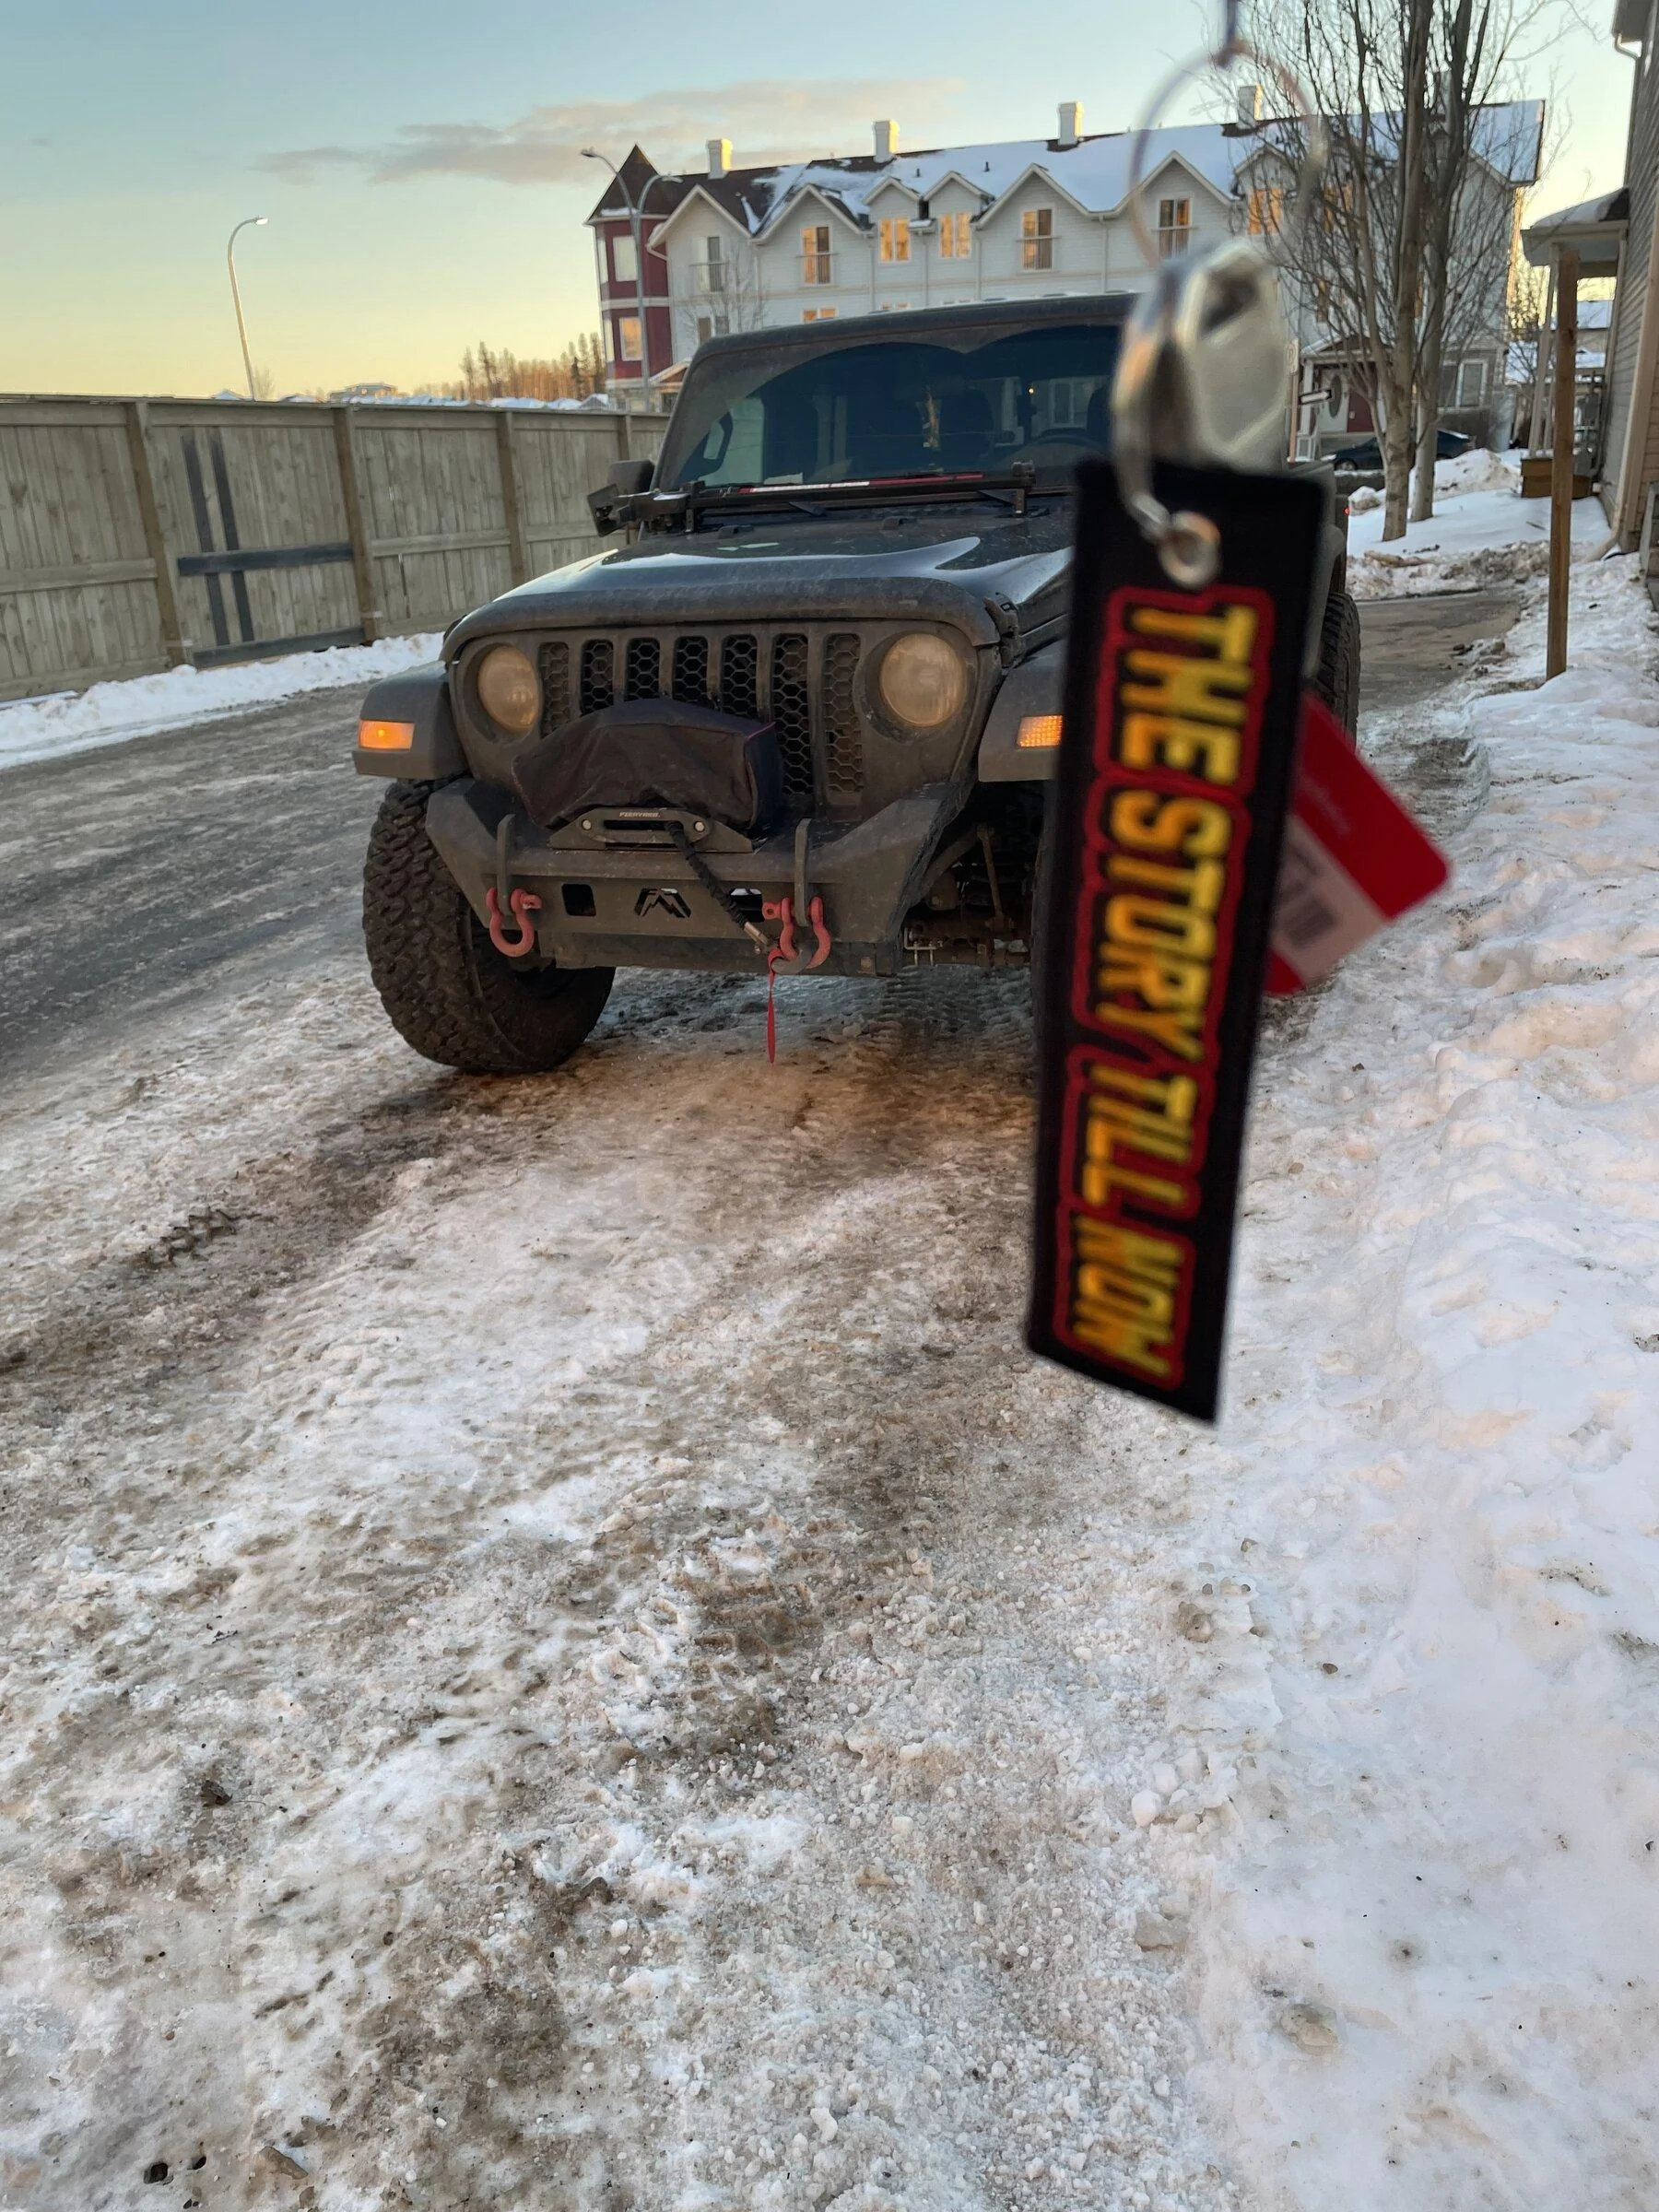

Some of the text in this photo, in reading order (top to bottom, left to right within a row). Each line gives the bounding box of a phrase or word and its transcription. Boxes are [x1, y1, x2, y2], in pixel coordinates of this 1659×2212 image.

[1072, 605, 1258, 1378] THE STORY TILL NOW
